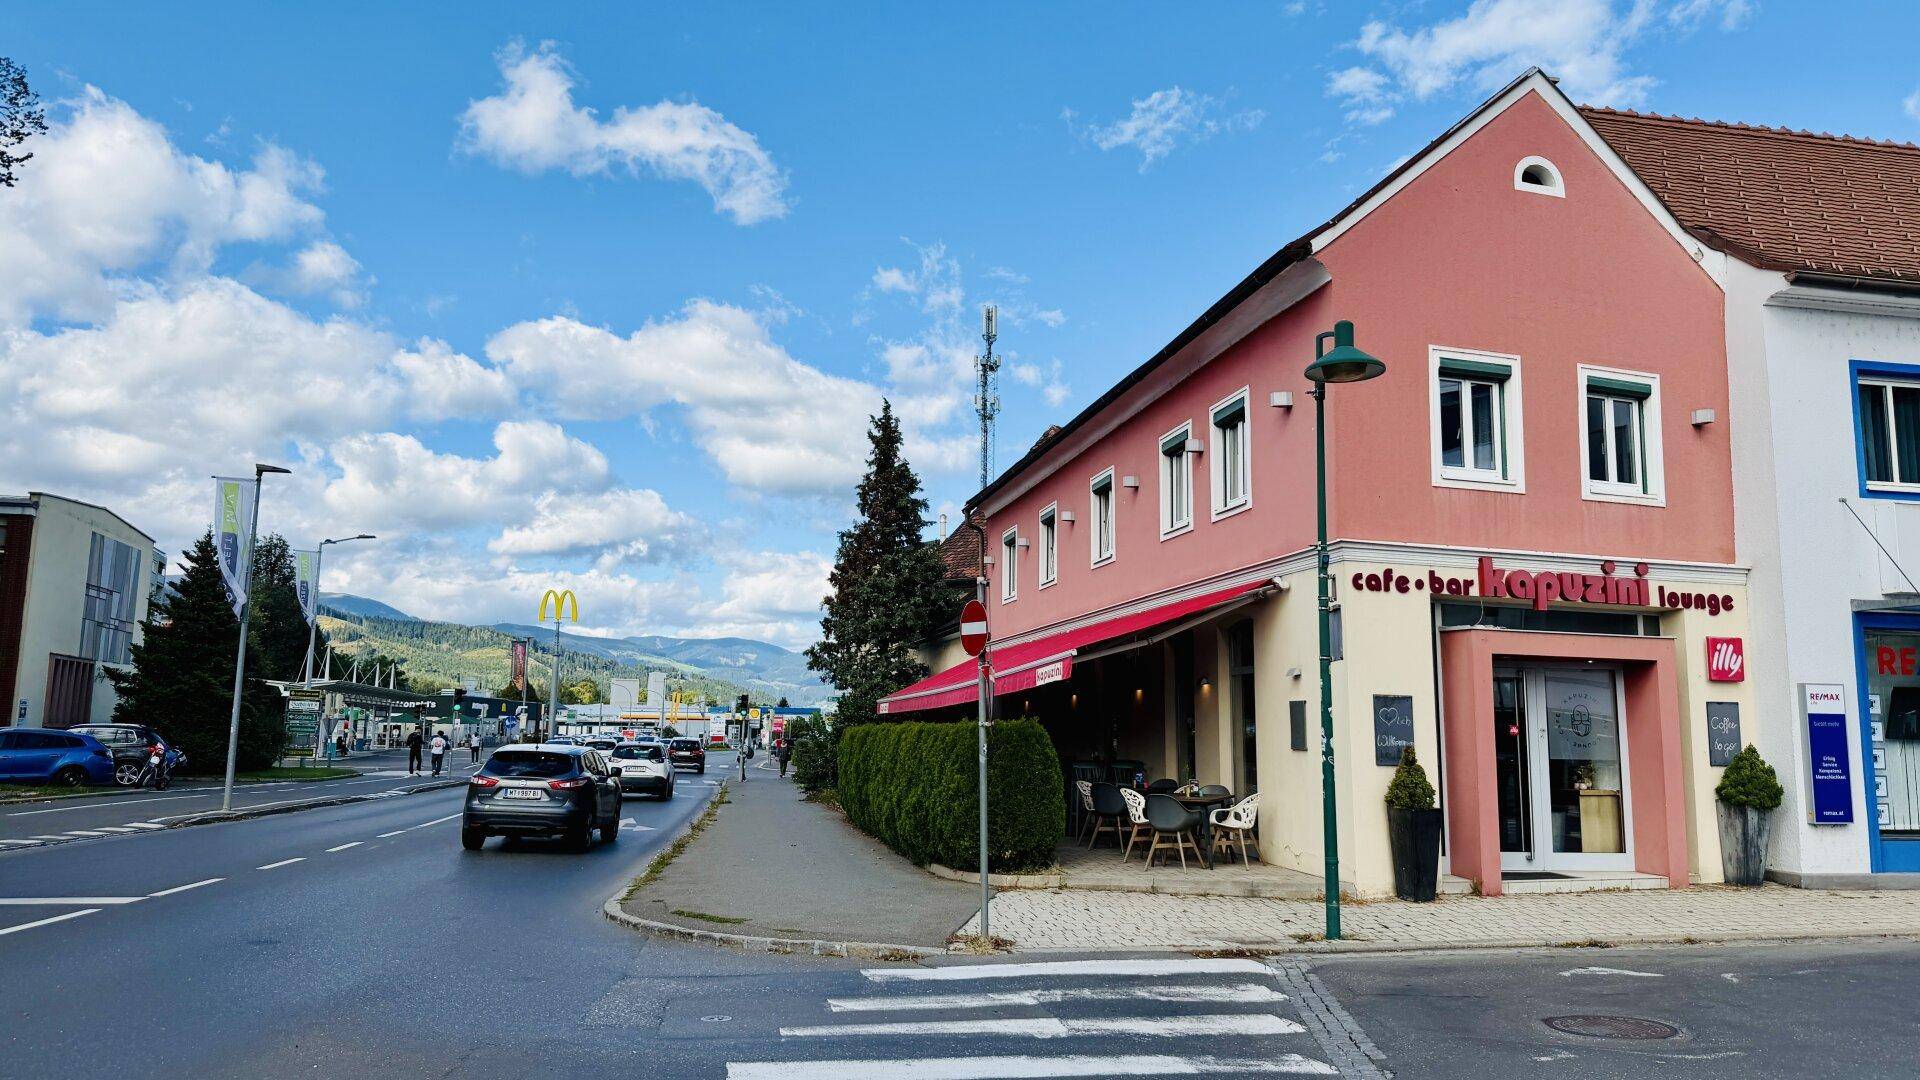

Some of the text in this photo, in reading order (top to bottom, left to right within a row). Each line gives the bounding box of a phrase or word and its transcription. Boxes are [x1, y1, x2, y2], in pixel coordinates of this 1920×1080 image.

[1352, 557, 1734, 616] cafe bar kapuzini lounge
[1712, 642, 1742, 677] illy
[1810, 693, 1840, 701] RE/MAX
[1710, 716, 1738, 734] Coffee
